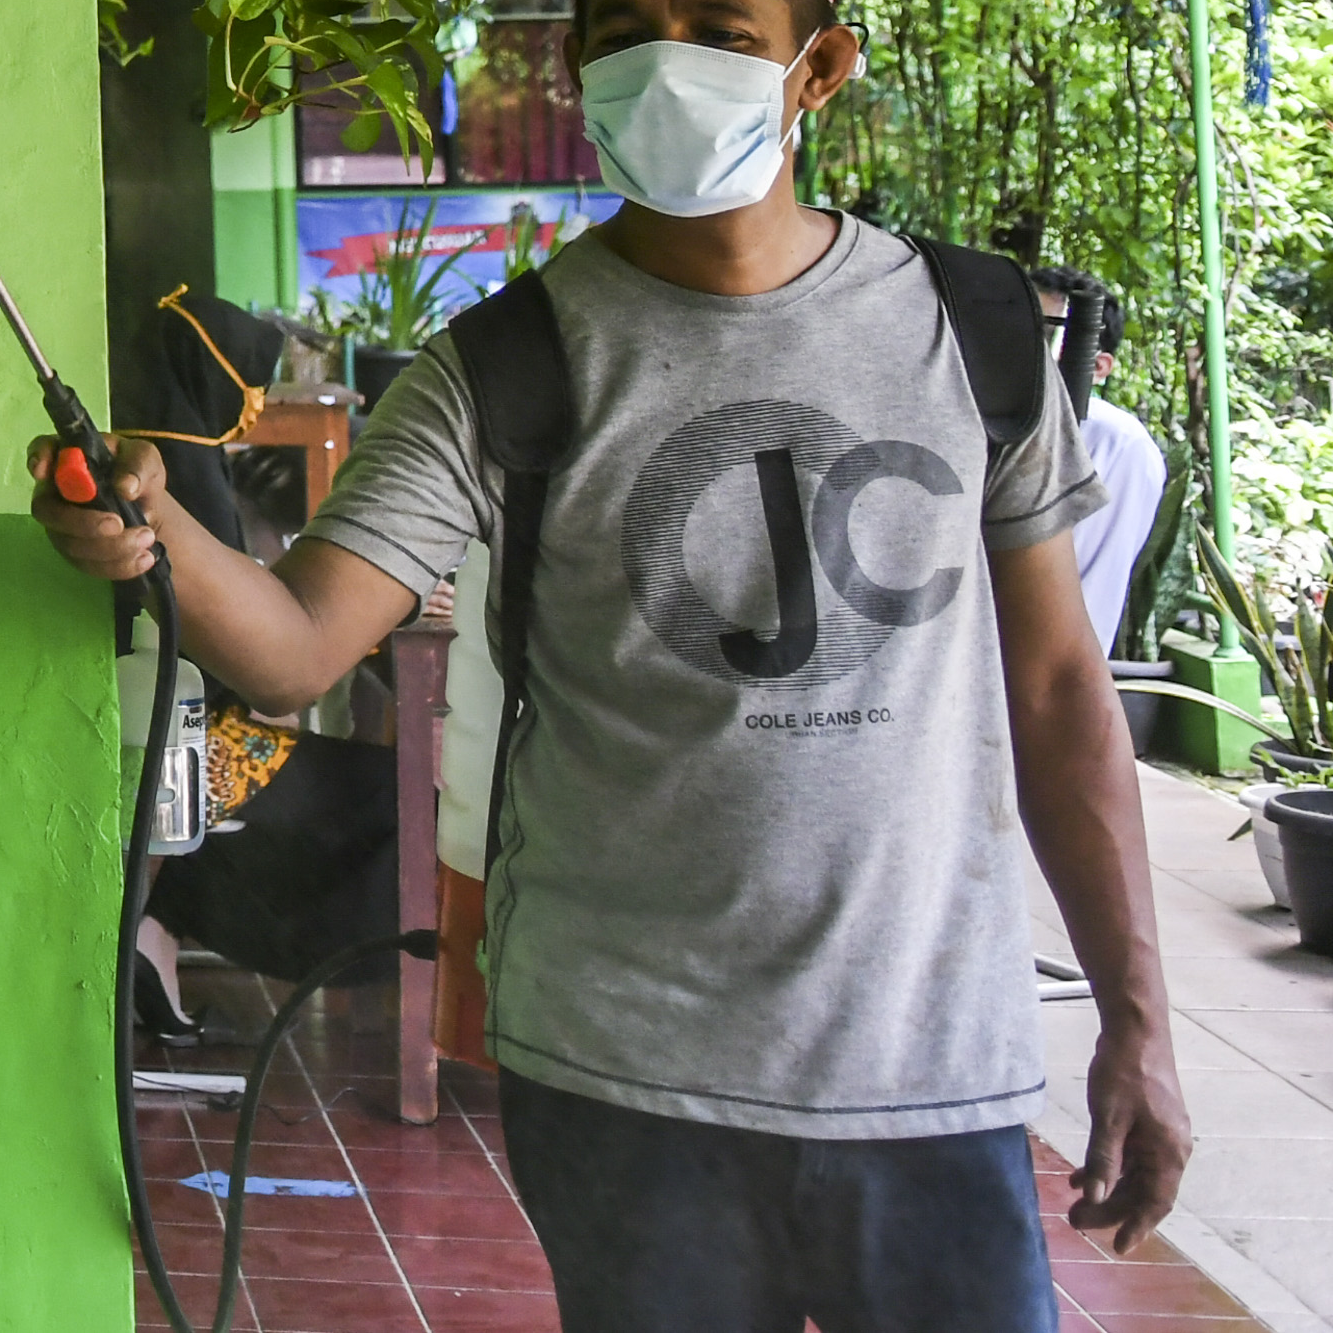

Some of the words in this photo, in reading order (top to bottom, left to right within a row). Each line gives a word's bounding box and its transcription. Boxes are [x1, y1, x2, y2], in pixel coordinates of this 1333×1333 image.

[745, 713, 797, 730] COLE
[803, 709, 862, 728] JEANS
[867, 707, 896, 724] CO.
